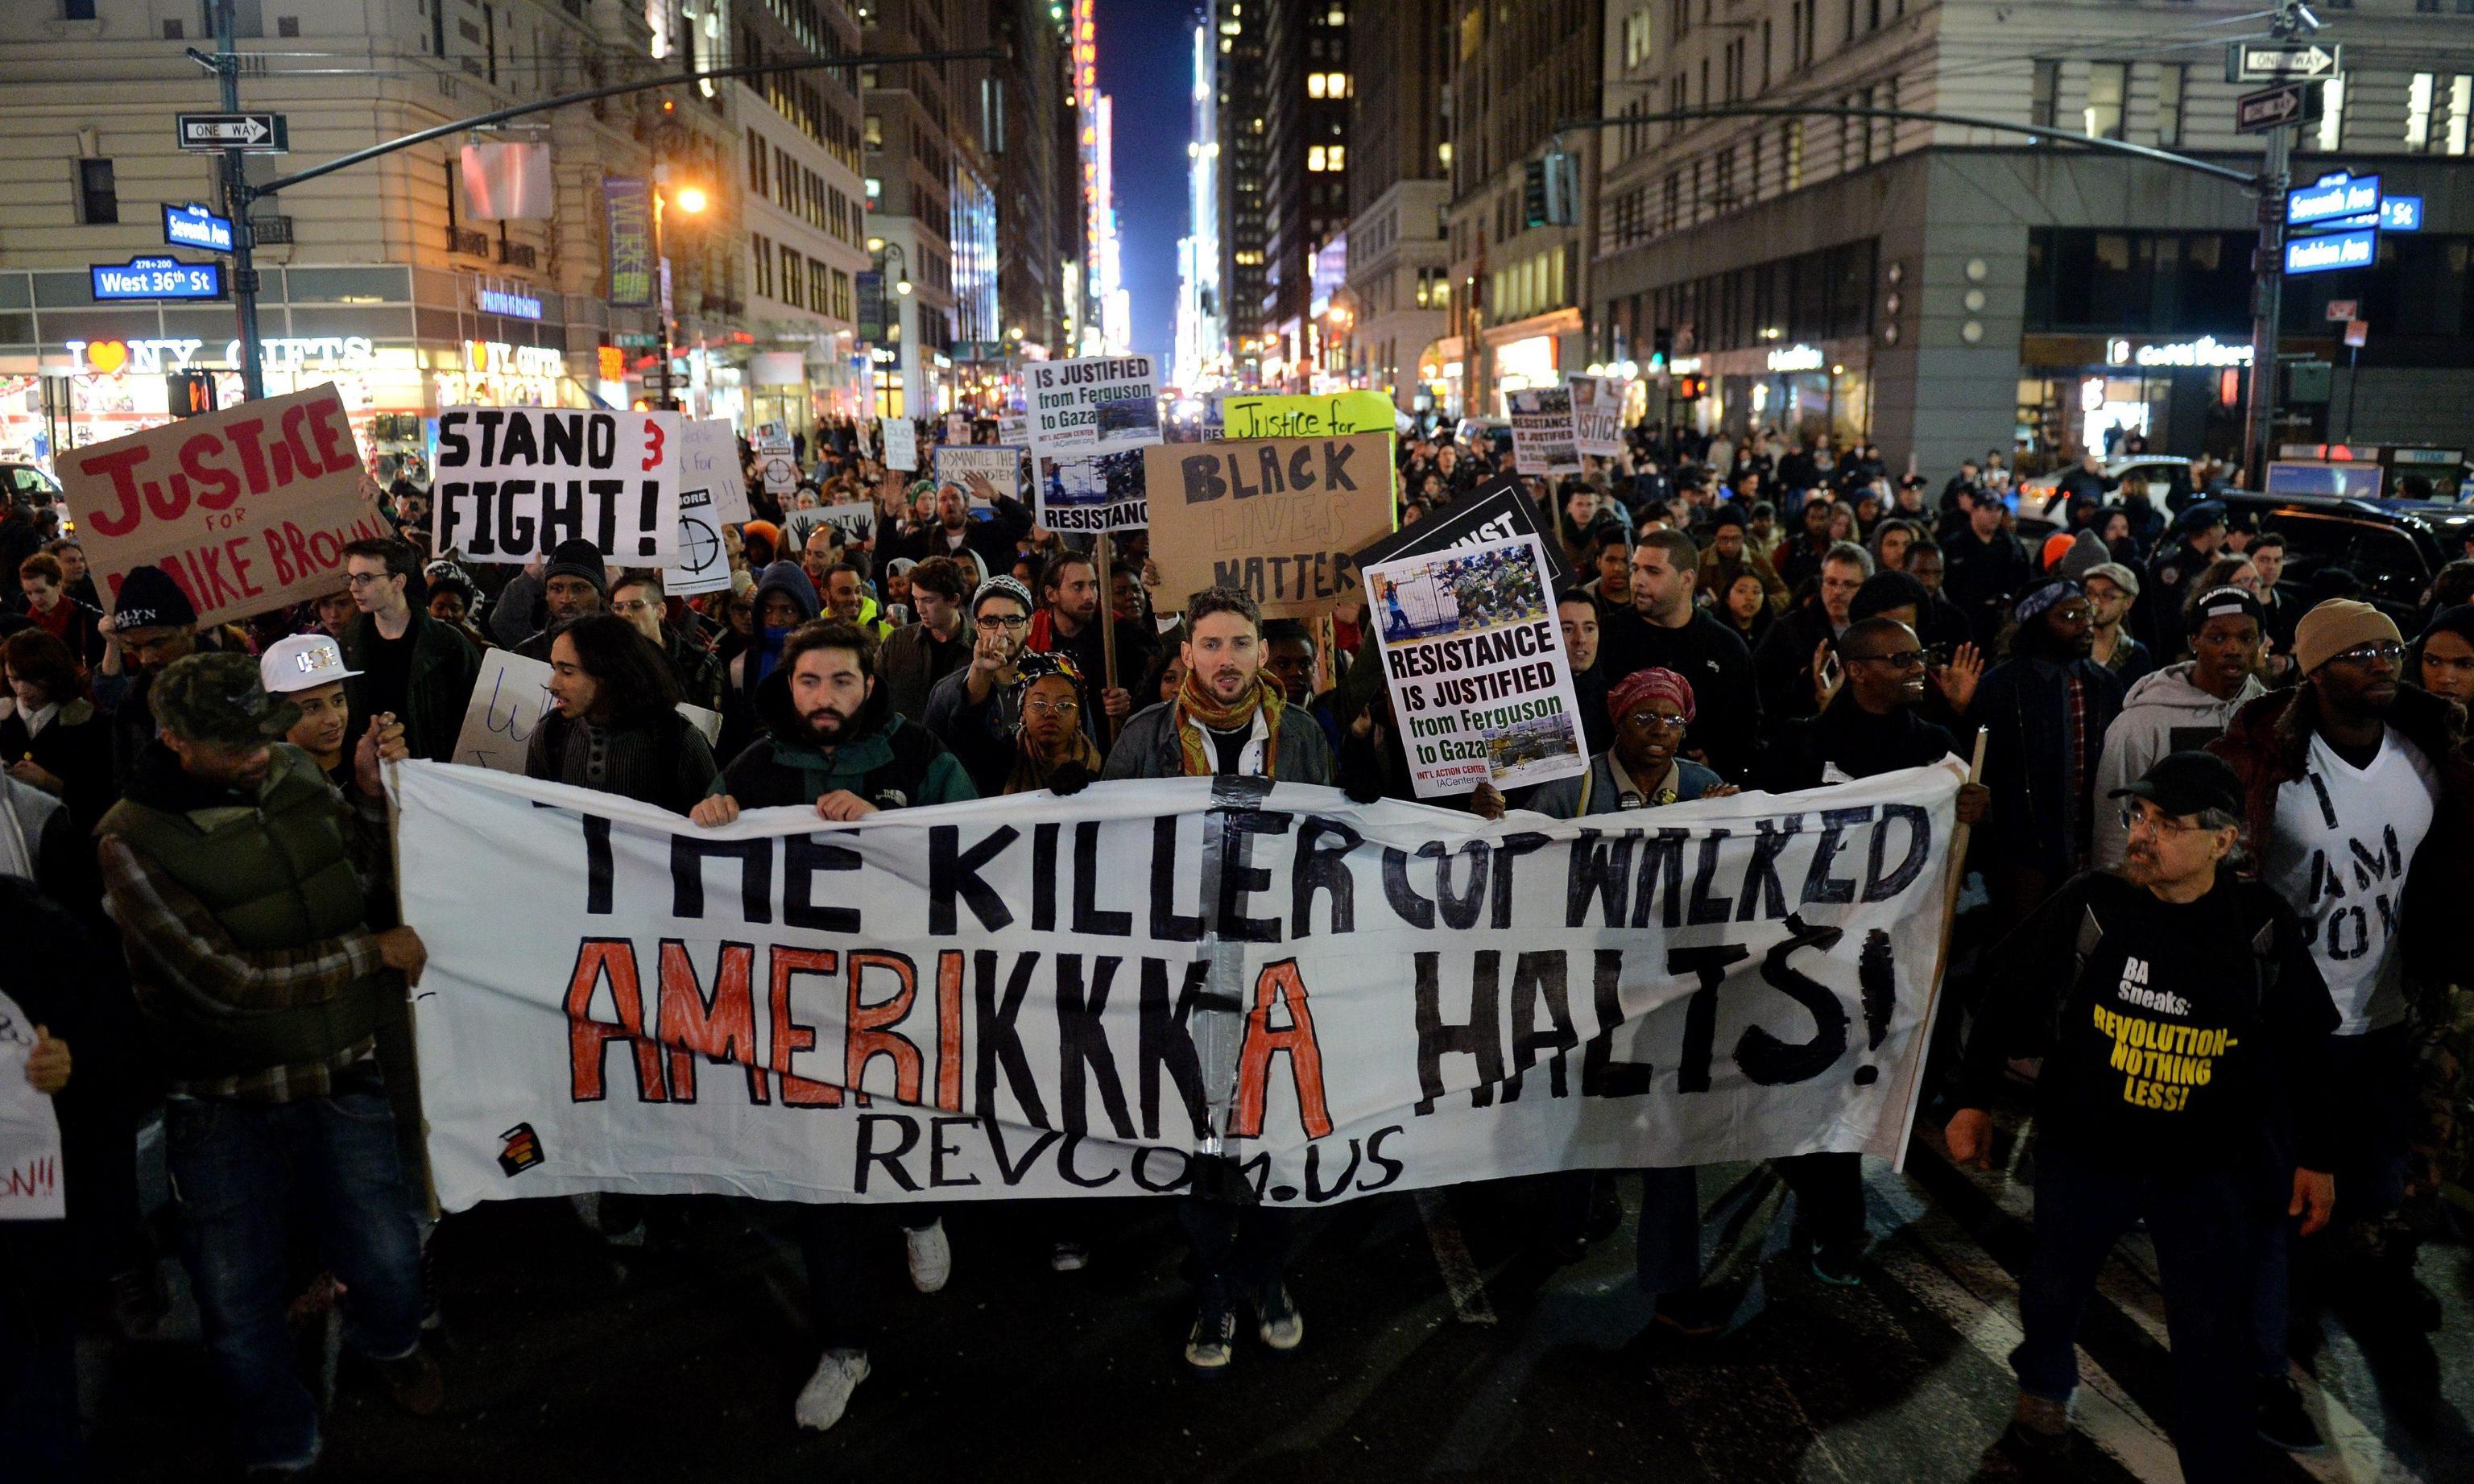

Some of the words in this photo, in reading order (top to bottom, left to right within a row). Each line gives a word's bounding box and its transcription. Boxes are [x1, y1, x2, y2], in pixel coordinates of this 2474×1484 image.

[196, 125, 221, 136] ONE
[232, 125, 258, 136] WAY
[169, 215, 210, 242] Seventh
[211, 223, 230, 246] Ave
[101, 273, 150, 292] West
[153, 271, 185, 291] 36th
[190, 271, 210, 291] St
[136, 260, 151, 269] 278
[157, 260, 172, 269] 200
[65, 341, 86, 375] I
[126, 339, 202, 374] NY
[1035, 368, 1053, 389] IS
[1060, 358, 1149, 386] JUSTIFIED
[1038, 392, 1074, 409] from
[1079, 383, 1152, 404] Ferguson
[1041, 413, 1056, 430] to
[1060, 411, 1096, 426] Gaza
[1235, 402, 1321, 438] Justice
[1327, 399, 1355, 435] for
[439, 411, 615, 469] STAND
[996, 449, 1016, 466] THE
[81, 398, 357, 537] JUSTICE
[1181, 440, 1359, 506] BLACK
[681, 490, 707, 506] ORE
[1045, 501, 1148, 529] RESISTANC
[206, 507, 246, 531] FOR
[439, 479, 659, 556] FIGHT!
[1212, 494, 1350, 552] LIVES
[1214, 551, 1357, 604] MATTER
[1388, 620, 1556, 680] RESISTANCE
[1400, 684, 1426, 713] IS
[1433, 660, 1557, 709] JUSTIFIED
[1409, 713, 1457, 739] from
[1462, 694, 1563, 731] Ferguson
[1417, 743, 1438, 766] to
[1440, 738, 1487, 763] Gaza
[1417, 771, 1434, 780] INT'L
[1436, 767, 1461, 778] ACTION
[1462, 765, 1487, 775] CENTER
[1436, 776, 1488, 788] IACenter.org
[532, 800, 863, 933] THE
[929, 810, 1364, 943] KILLER
[1382, 831, 1554, 931] COP
[1565, 803, 1931, 930] WALKED
[2122, 956, 2149, 985] BA
[2117, 979, 2192, 1016] Speaks:
[561, 936, 1334, 1140] AMERIKKKA
[1413, 911, 1897, 1117] HALTS!
[2093, 1003, 2238, 1057] REVOLUTION-
[2110, 1040, 2212, 1086] NOTHING
[2123, 1075, 2190, 1112] LESS!
